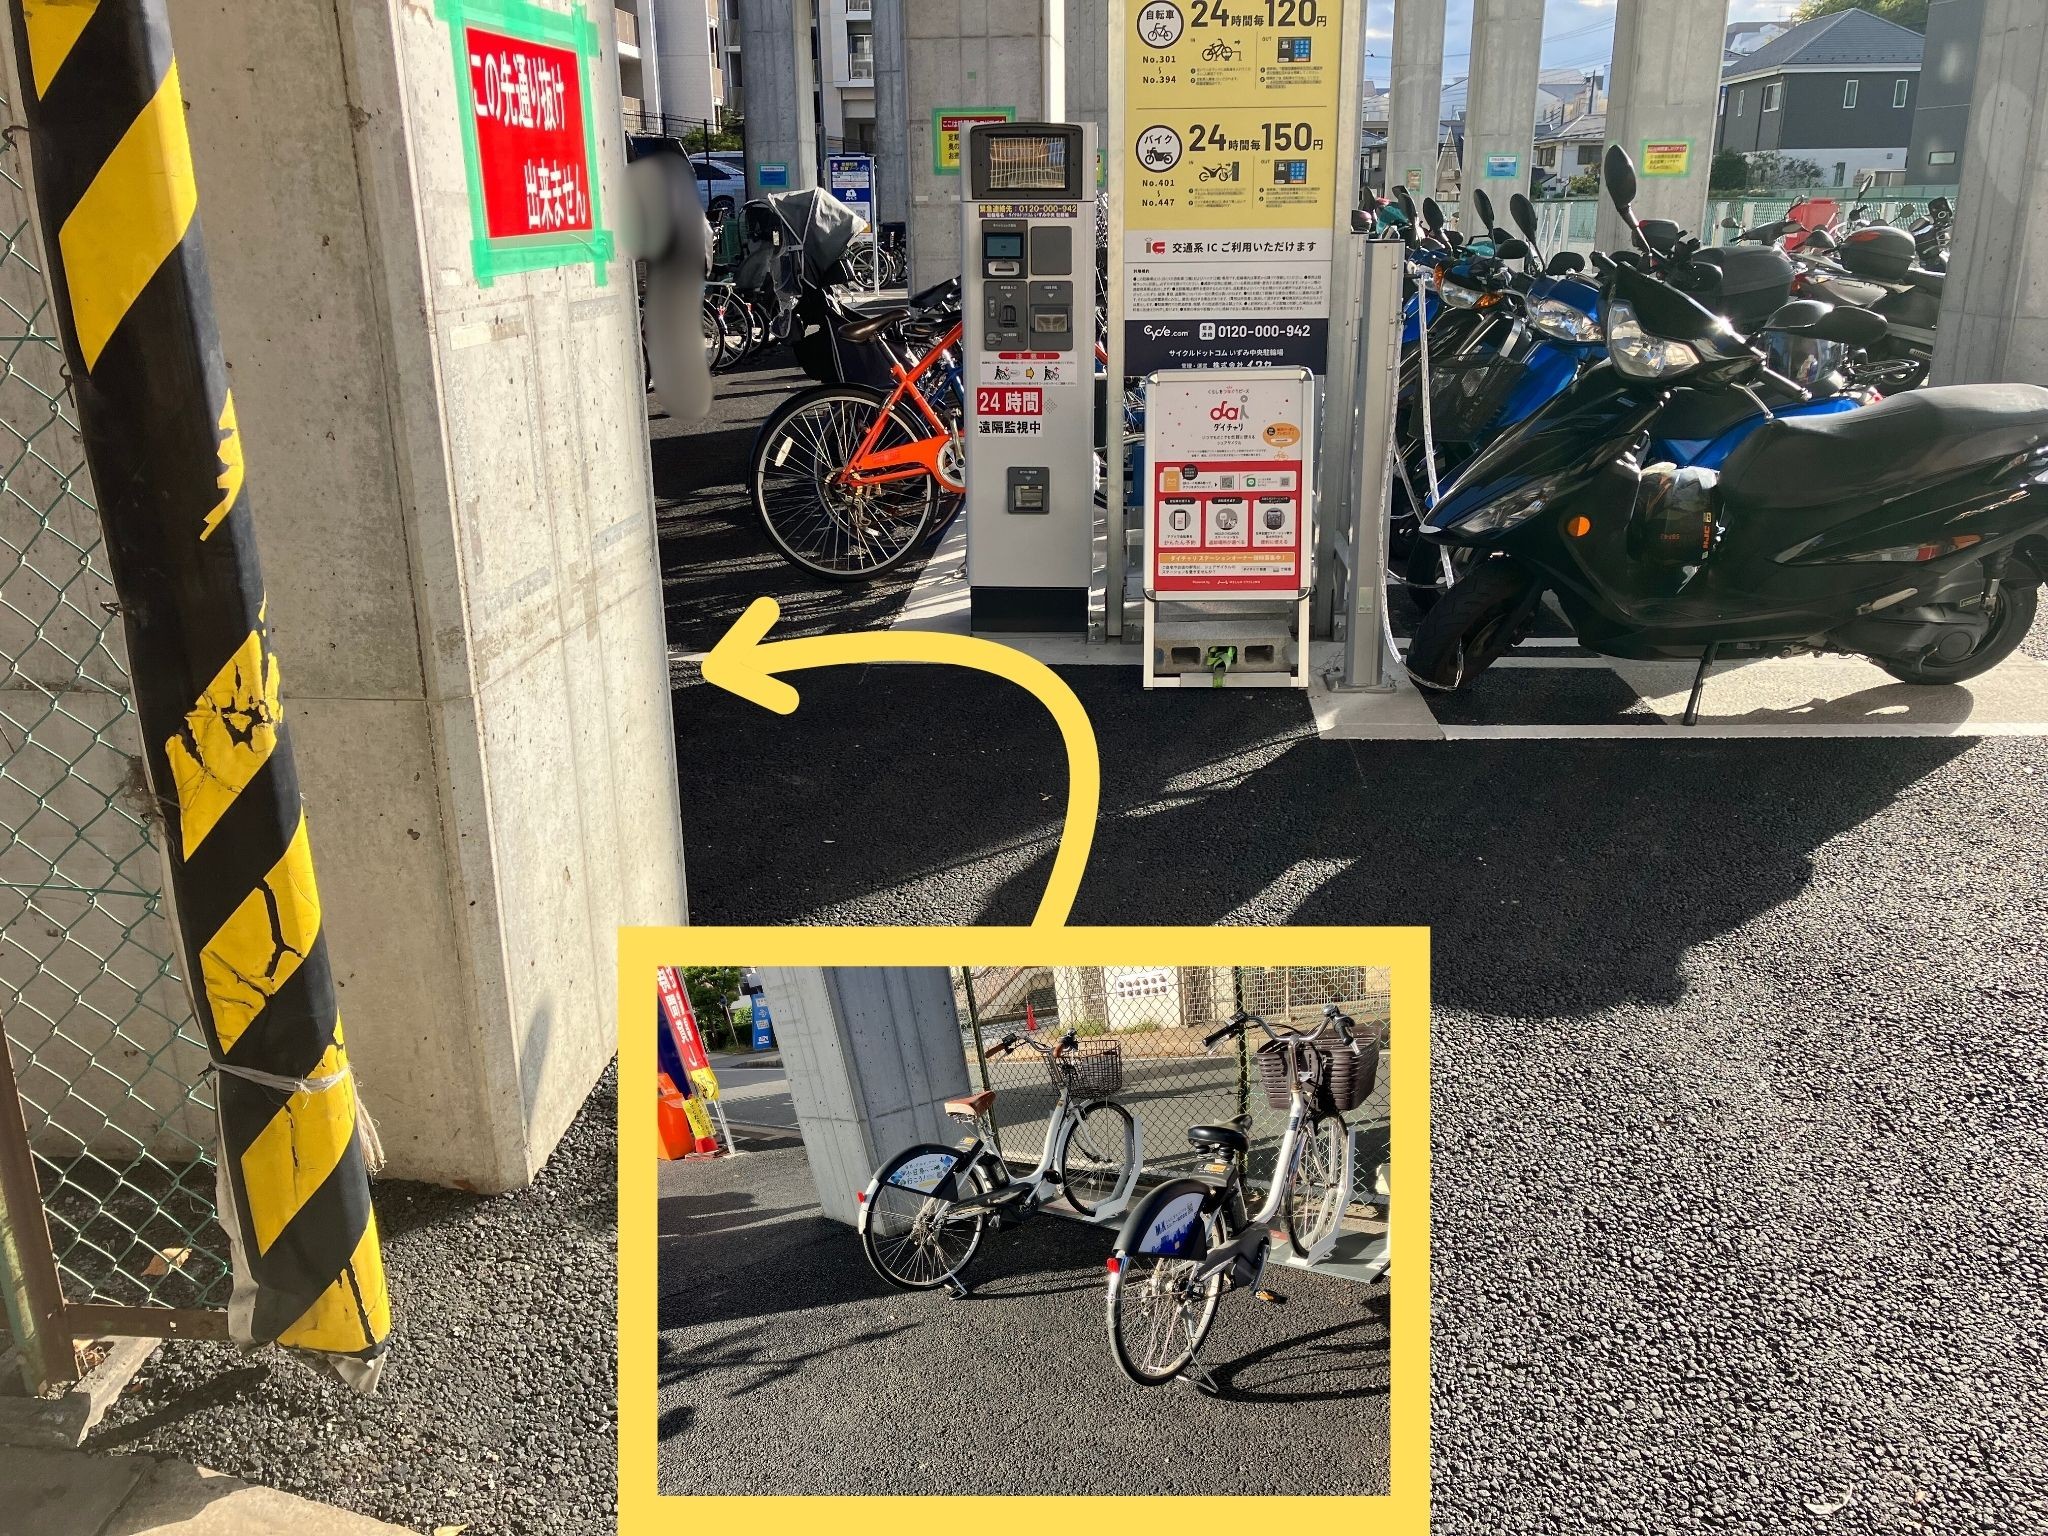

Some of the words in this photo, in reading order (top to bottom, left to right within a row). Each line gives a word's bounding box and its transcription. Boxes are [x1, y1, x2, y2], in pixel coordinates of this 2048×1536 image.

[1146, 10, 1174, 20] 自転車
[1142, 76, 1176, 84] No.394
[470, 51, 565, 130] この先通り抜け
[1144, 135, 1172, 144] バイク
[524, 158, 586, 229] 出来ません
[1142, 198, 1174, 206] No.447
[1172, 242, 1203, 253] 交通系
[1207, 242, 1218, 252] IC
[1222, 241, 1316, 252] ご利用いただけます
[1218, 325, 1310, 338] 0120-000-942
[1230, 348, 1284, 356] いずみ中央駐輪場
[1006, 392, 1038, 412] 時間
[1210, 395, 1250, 420] dai
[978, 420, 1041, 434] 遠隔監視中
[1214, 423, 1244, 432] ダイチャリ
